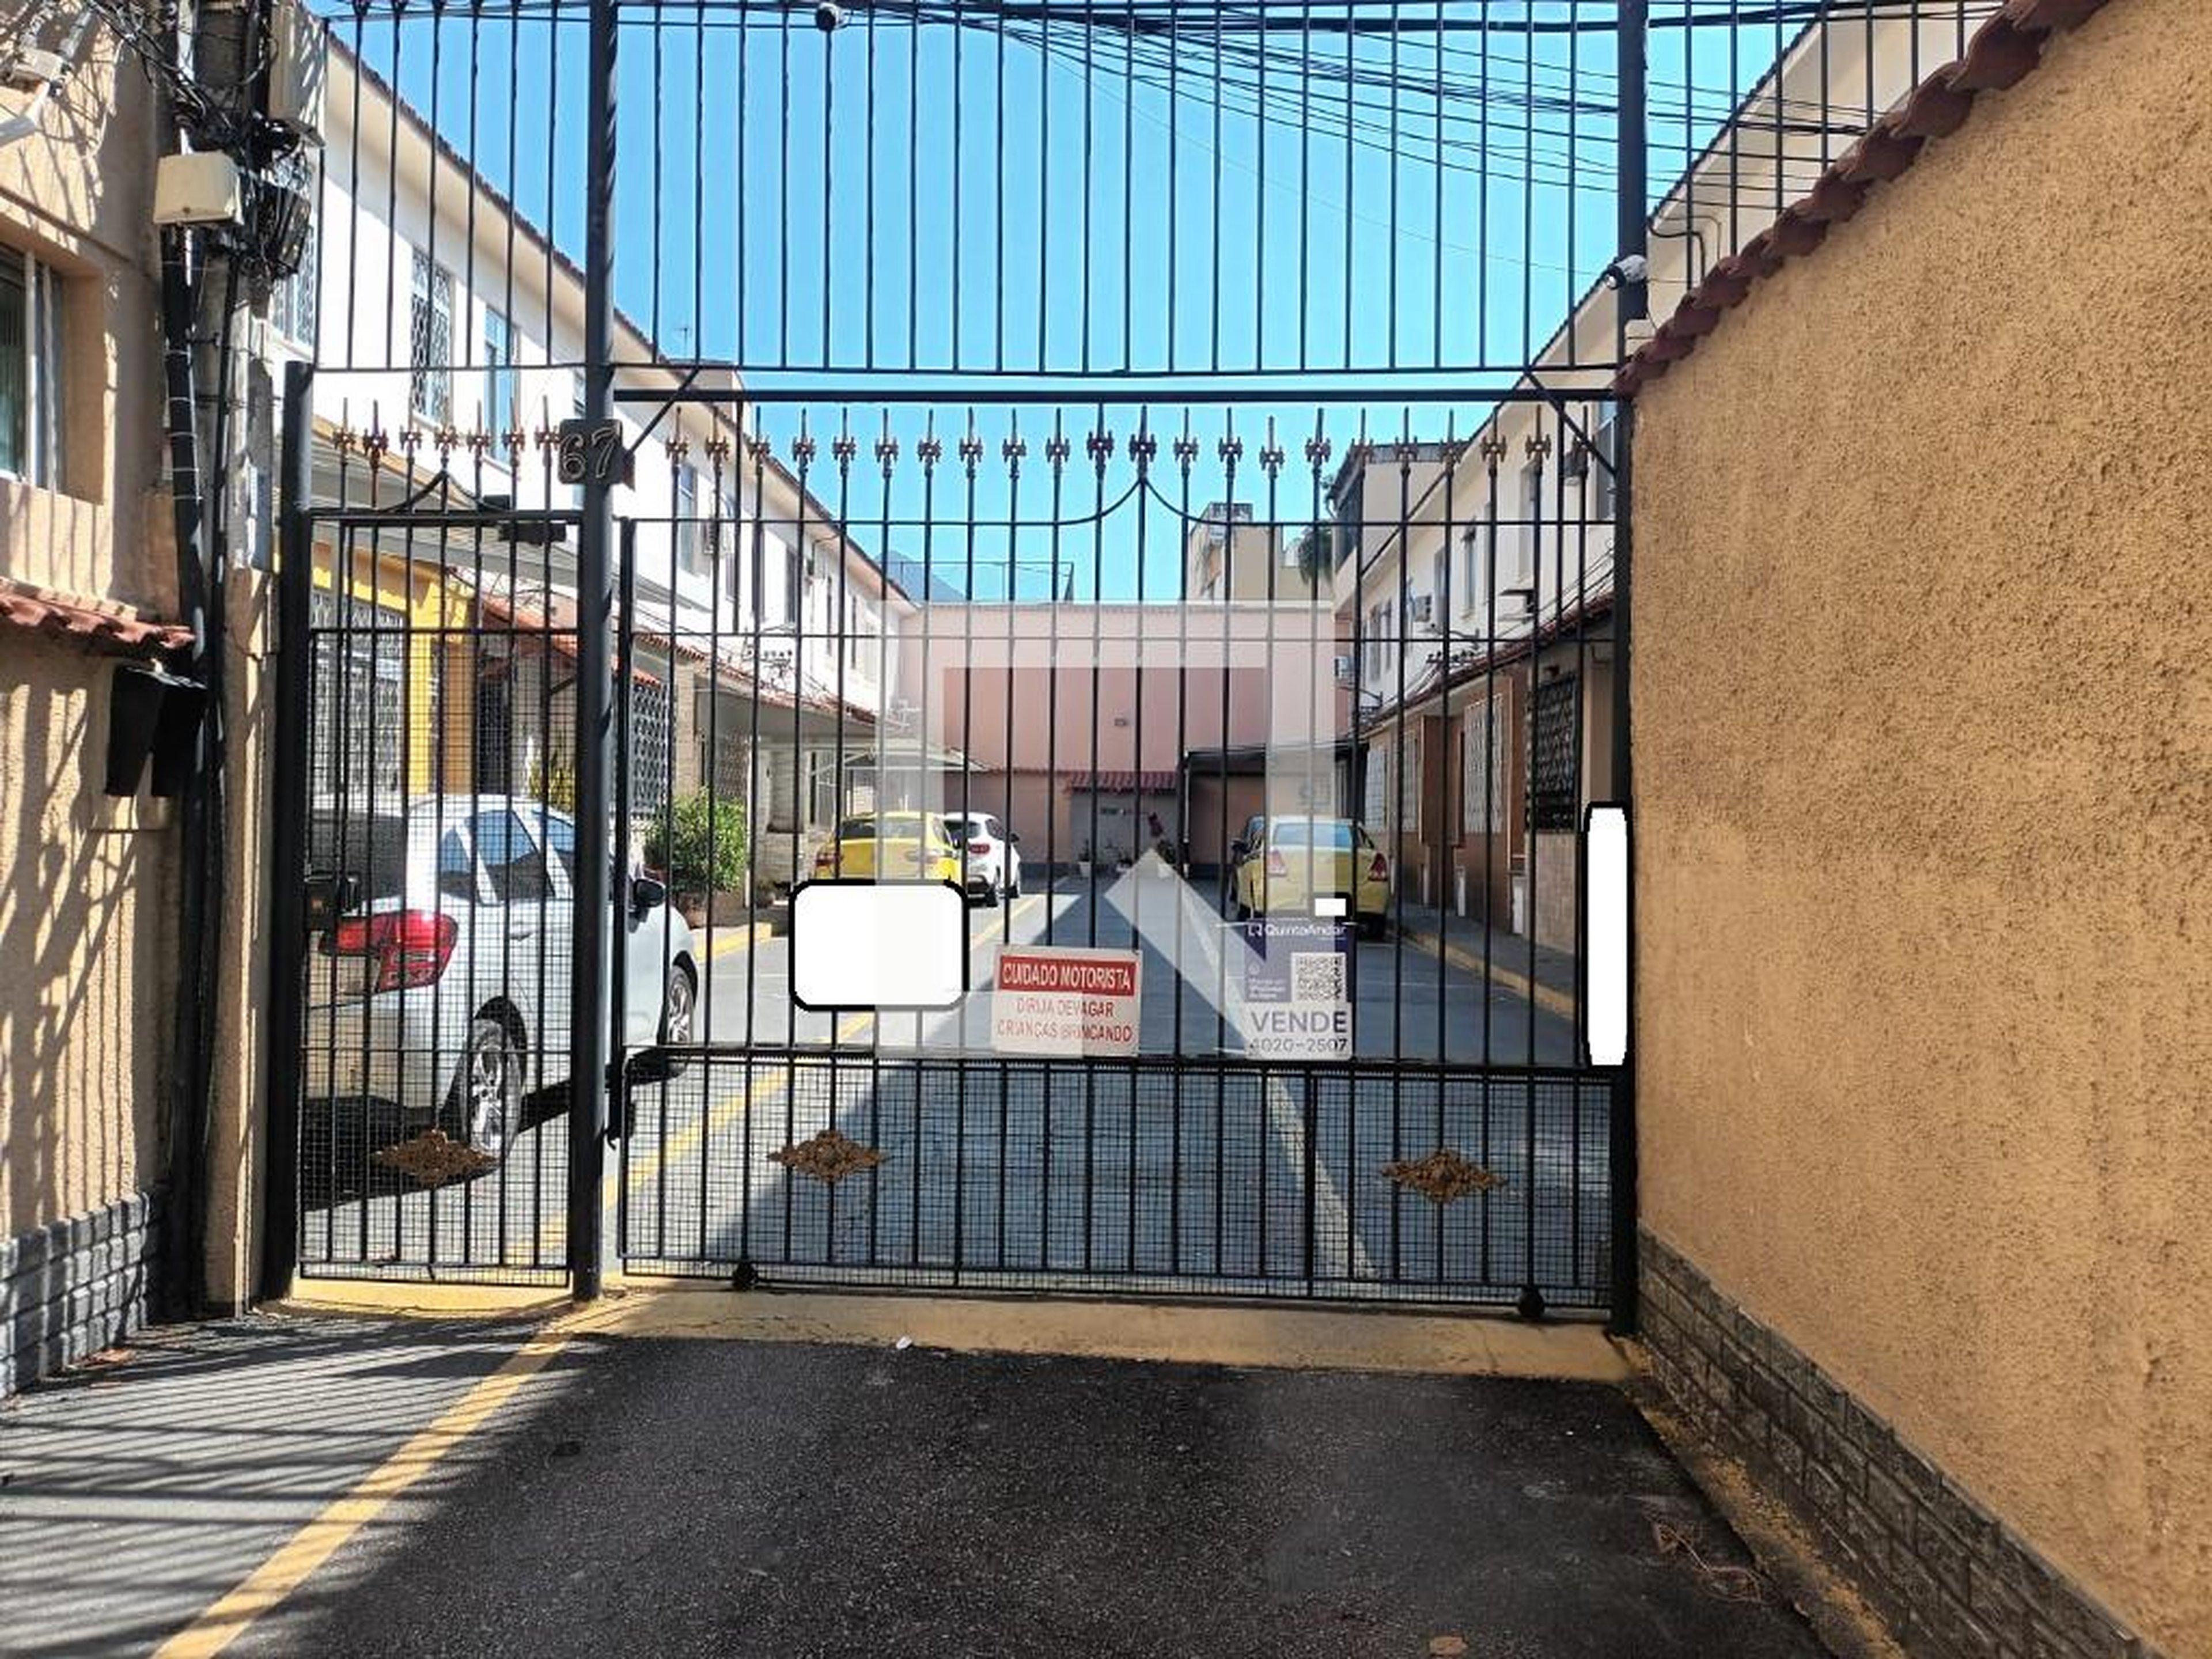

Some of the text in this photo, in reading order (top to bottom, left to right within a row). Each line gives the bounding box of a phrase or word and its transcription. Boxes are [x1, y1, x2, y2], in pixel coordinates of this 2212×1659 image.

[560, 427, 617, 479] 67
[1003, 963, 1131, 990] CUIDADO MOTORISTA
[1251, 1011, 1347, 1033] VENDE
